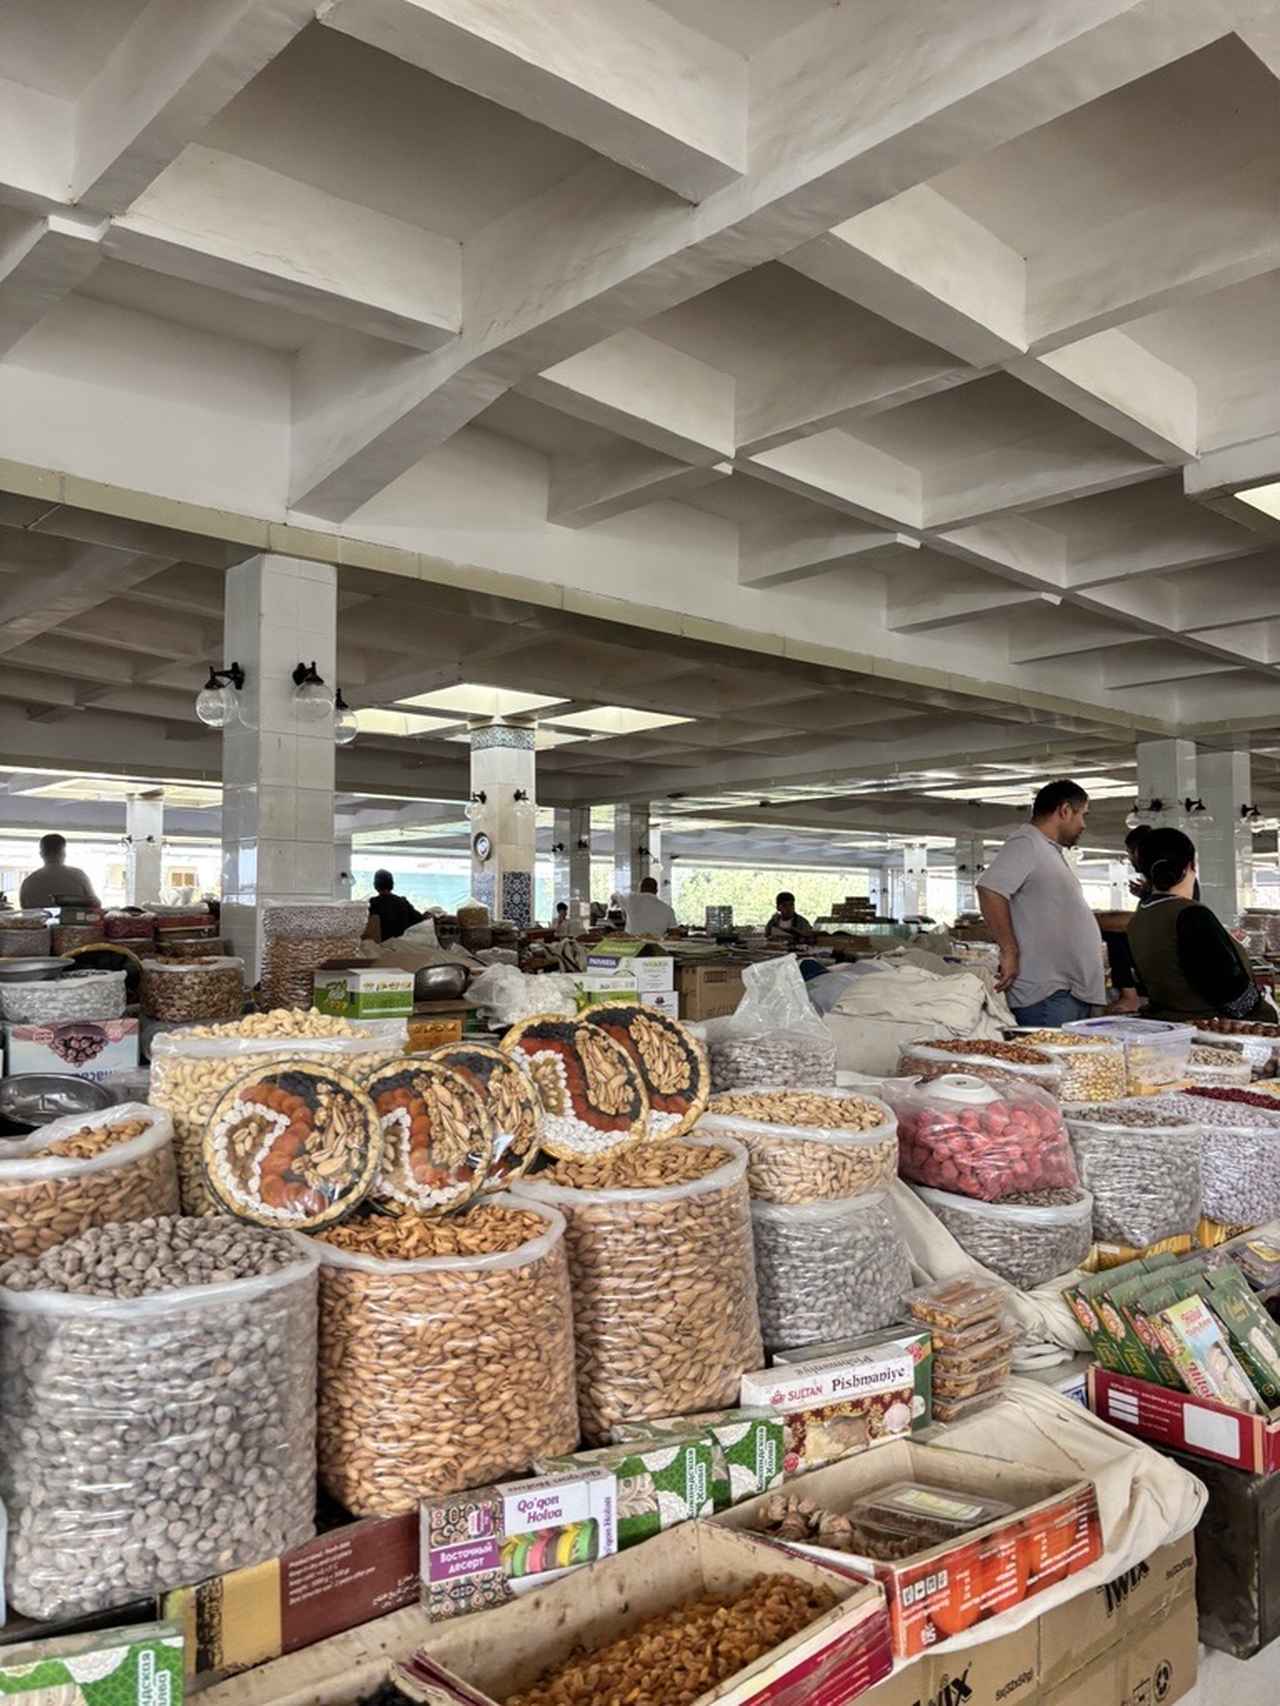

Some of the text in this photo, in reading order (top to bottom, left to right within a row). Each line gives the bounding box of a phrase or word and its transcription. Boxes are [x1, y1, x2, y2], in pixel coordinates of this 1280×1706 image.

[787, 1366, 906, 1403] SULTAN Pishmaniye
[526, 1507, 563, 1525] Holva
